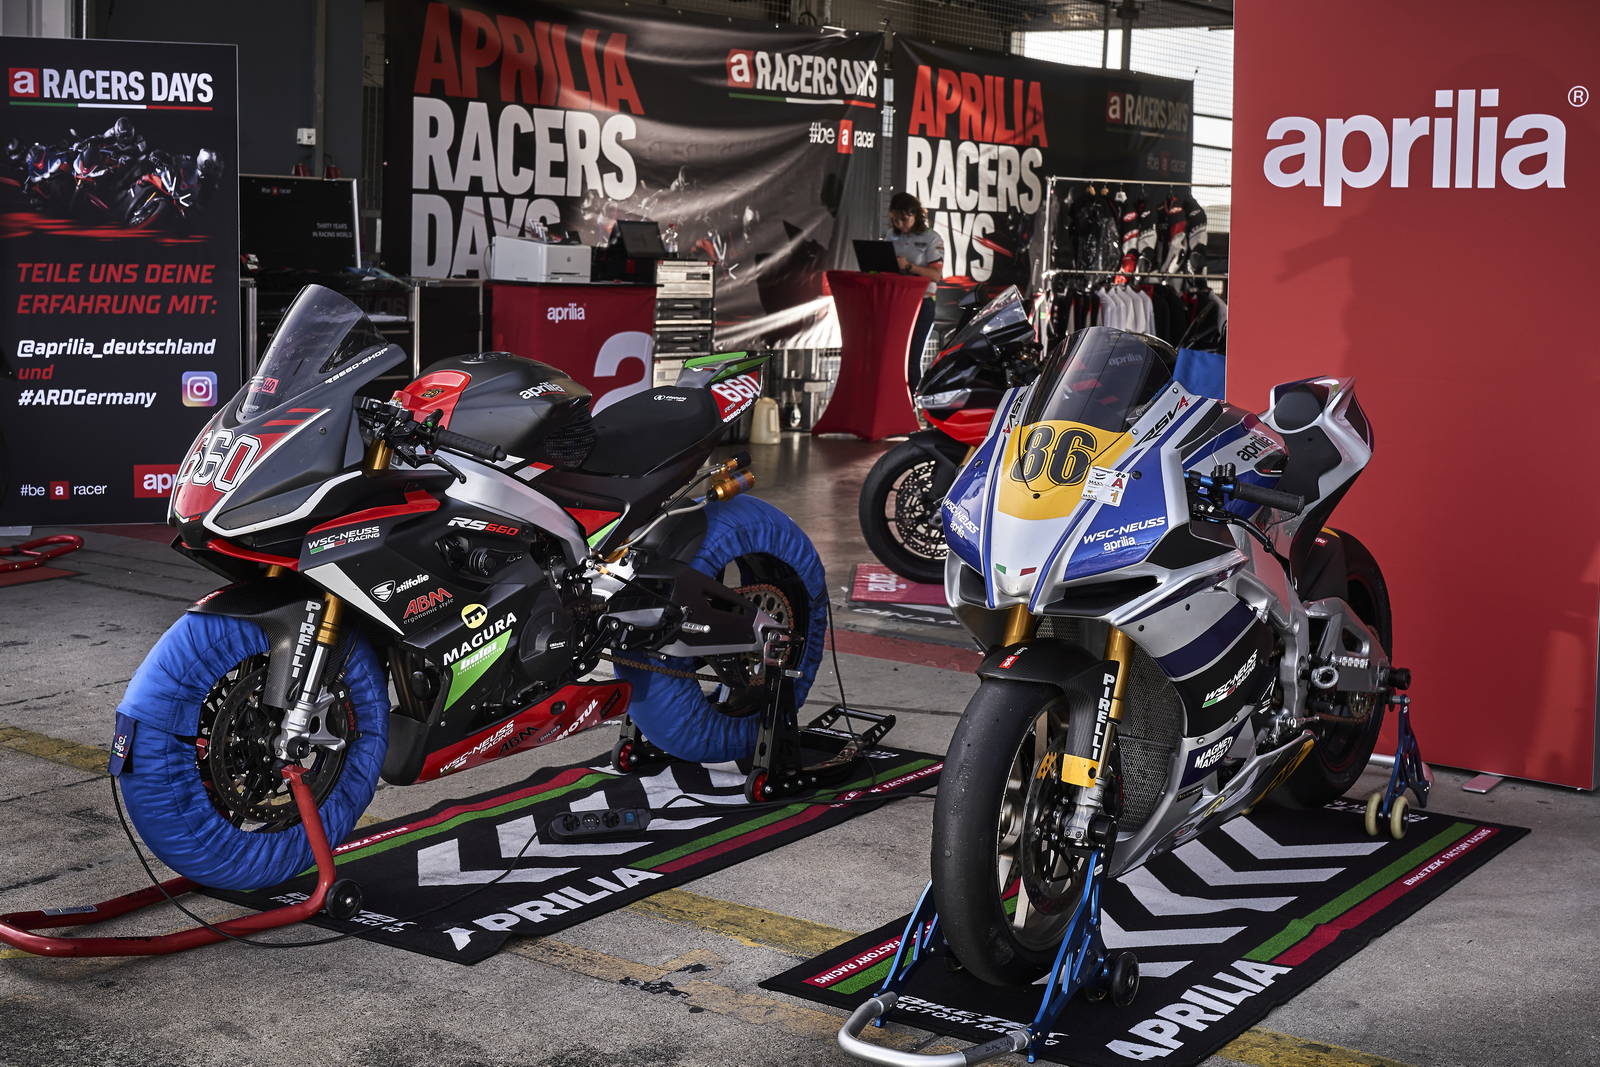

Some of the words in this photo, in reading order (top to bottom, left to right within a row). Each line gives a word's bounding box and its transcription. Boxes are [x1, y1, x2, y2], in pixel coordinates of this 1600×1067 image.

[413, 3, 645, 115] APRILIA
[13, 71, 35, 94] a
[43, 68, 145, 101] RACERS
[152, 72, 214, 103] DAYS
[755, 51, 837, 96] RACERS
[840, 60, 878, 98] DAYS
[908, 64, 1048, 148] APRILIA
[1124, 94, 1167, 129] RACERS
[1167, 102, 1189, 132] DAYS
[412, 97, 637, 200] RACERS
[809, 122, 835, 146] #be
[853, 130, 875, 149] racer
[1263, 88, 1566, 207] aprilia
[906, 136, 1043, 215] RACERS
[929, 211, 995, 282] AYS
[16, 263, 82, 283] TEILE
[89, 263, 139, 284] UNS
[145, 263, 216, 284] DEINE
[16, 294, 161, 315] ERFAHRUNG
[168, 295, 217, 316] MIT:
[547, 303, 586, 324] aprilia
[17, 338, 216, 359] @aprilia_deutschland
[18, 364, 54, 381] und
[18, 389, 156, 408] #ARDGermany
[519, 381, 566, 399] aprilia
[711, 374, 760, 403] 660
[1134, 396, 1190, 446] RSV4
[177, 428, 260, 492] 660
[1010, 424, 1097, 487] 86
[1237, 434, 1275, 461] aprilia
[20, 483, 45, 497] #be
[73, 483, 107, 496] racer
[1111, 478, 1123, 489] A
[1111, 491, 1119, 503] 1
[447, 517, 519, 536] RS660
[944, 498, 979, 534] WSC-NEUSS
[1083, 516, 1165, 545] WSC-NEUSS
[308, 526, 380, 550] WSC-NEUSS
[347, 532, 381, 544] RACING
[1103, 536, 1136, 552] aprilia
[396, 573, 430, 595] stilfolie
[403, 587, 453, 619] ABM
[403, 606, 438, 626] ergonomic
[437, 597, 455, 614] style
[291, 600, 321, 678] PIRELLI
[442, 612, 518, 666] MAGURA
[1205, 649, 1258, 702] WSC-NEUSS
[555, 698, 599, 741] MOTUL
[1093, 673, 1115, 760] PIRELLI
[439, 719, 515, 774] WSC-NEUSS
[480, 728, 514, 753] RACING
[1403, 859, 1446, 886] BIKETEK
[1442, 841, 1472, 860] FACTORY
[1467, 828, 1492, 844] RACING
[855, 939, 902, 966] FACTORY
[814, 962, 858, 985] RACING
[895, 1002, 977, 1025] ACTORY
[1105, 958, 1294, 1061] APRILIA
